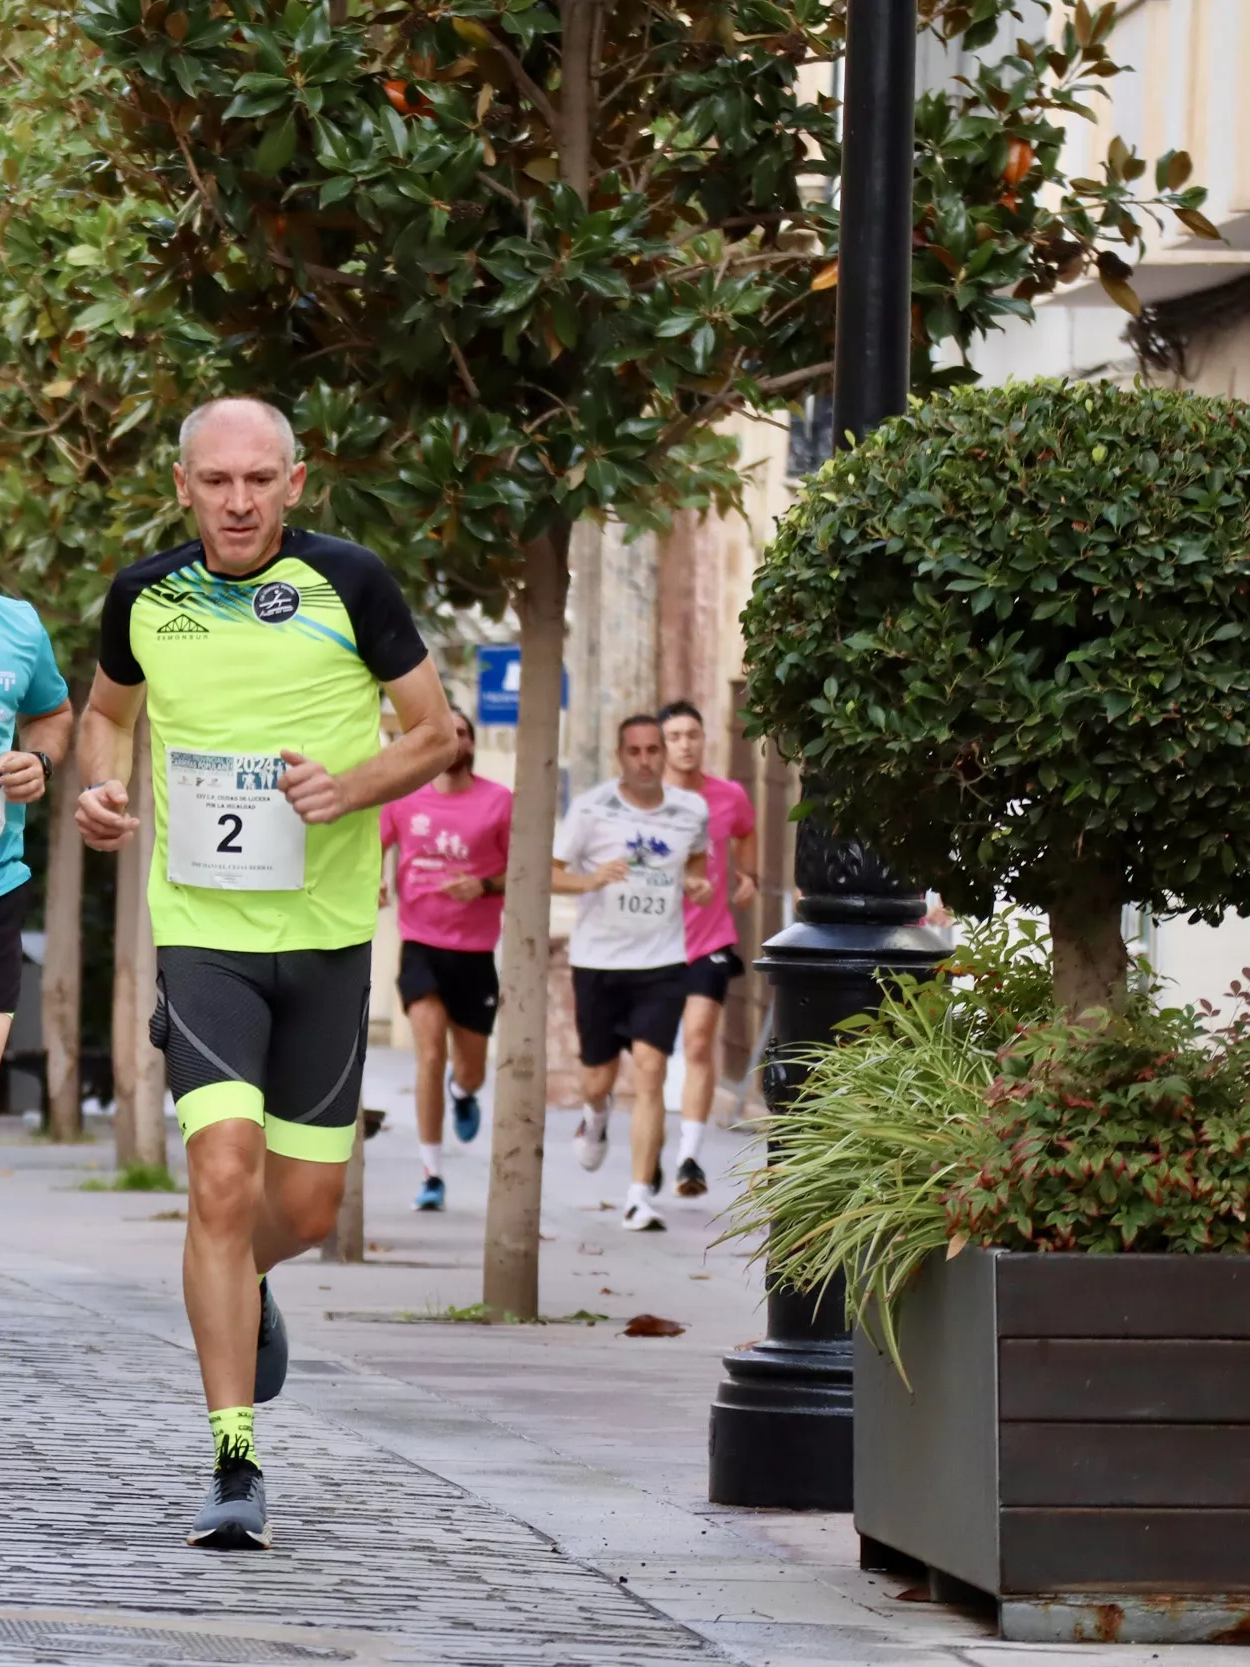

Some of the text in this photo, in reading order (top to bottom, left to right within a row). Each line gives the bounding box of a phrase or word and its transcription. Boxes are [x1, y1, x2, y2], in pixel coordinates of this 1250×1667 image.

[236, 757, 273, 773] 2024
[216, 813, 243, 853] 2
[618, 894, 666, 915] 1023
